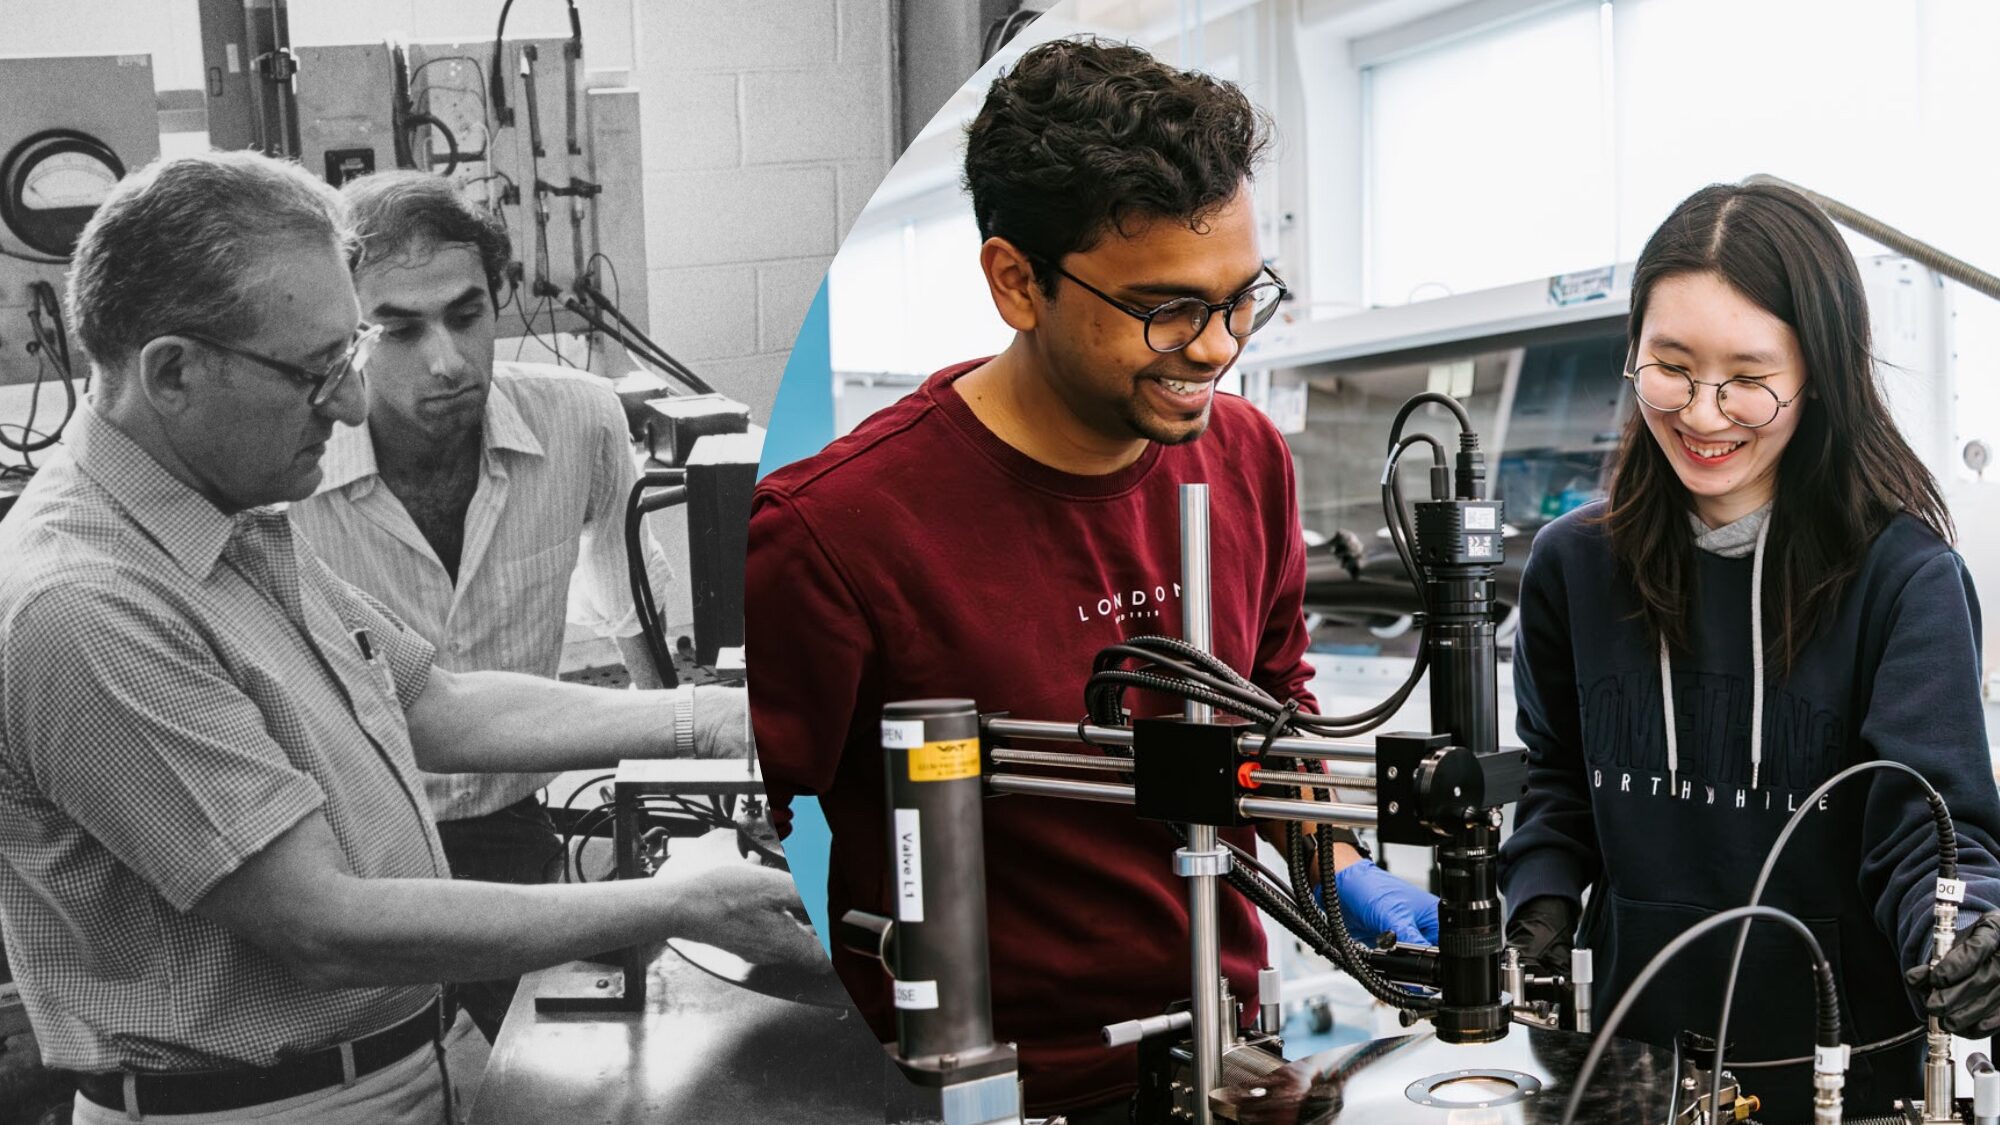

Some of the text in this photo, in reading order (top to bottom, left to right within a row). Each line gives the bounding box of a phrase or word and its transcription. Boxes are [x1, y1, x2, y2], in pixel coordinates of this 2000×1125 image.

[1579, 671, 1842, 790] OMETHING
[902, 832, 915, 898] Valve L1
[1938, 883, 1955, 895] DC
